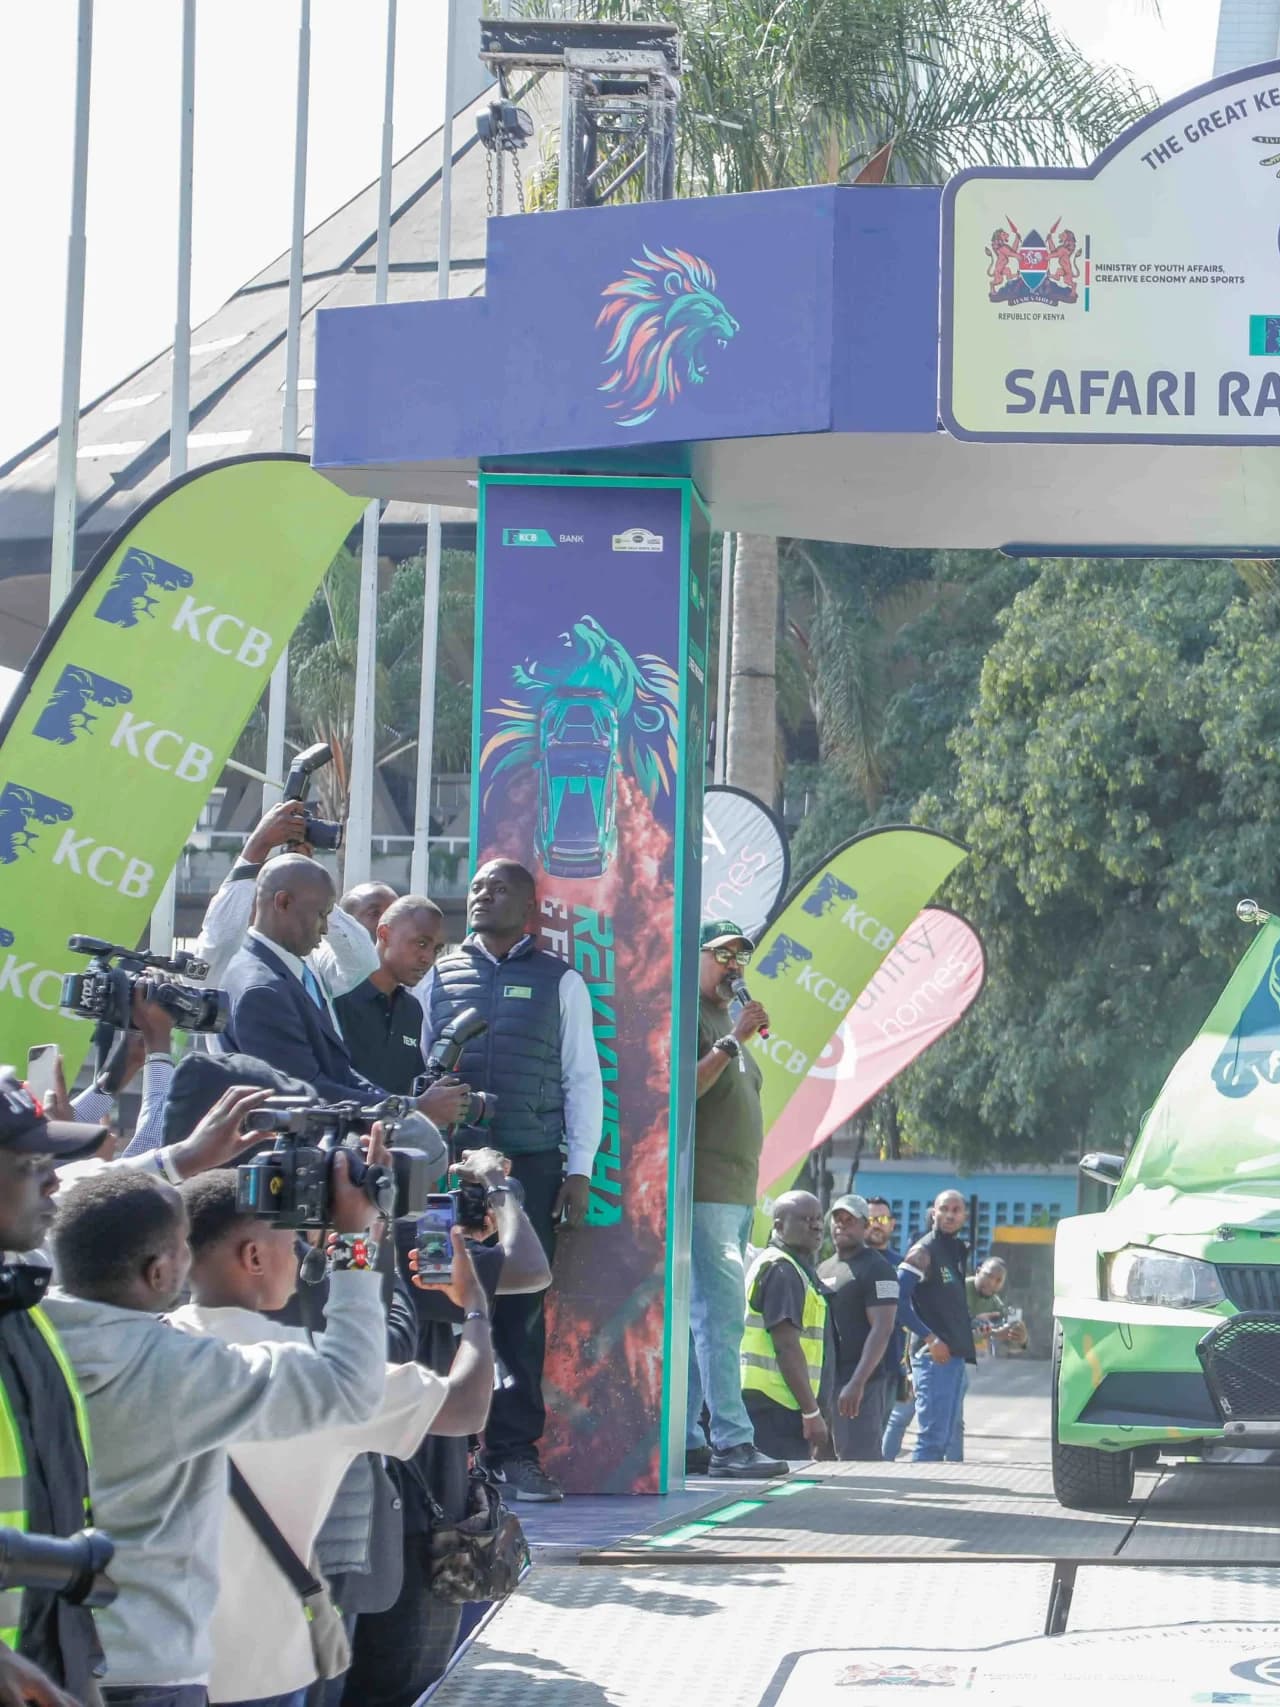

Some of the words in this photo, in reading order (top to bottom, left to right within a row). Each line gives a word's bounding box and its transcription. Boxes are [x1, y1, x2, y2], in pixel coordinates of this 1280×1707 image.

[1140, 136, 1184, 171] THE
[1183, 99, 1249, 143] GREAT
[1095, 263, 1137, 273] MINISTRY
[1139, 263, 1153, 273] OF
[1153, 264, 1185, 273] YOUTH
[1186, 264, 1225, 275] AFFAIRS,
[1095, 274, 1139, 284] CREATIVE
[1140, 274, 1187, 284] ECONOMY
[1188, 275, 1209, 284] AND
[1210, 275, 1246, 285] SPORTS
[998, 312, 1032, 321] REPUBLIC
[1032, 313, 1042, 321] OF
[1042, 313, 1065, 321] KENYA
[1004, 368, 1196, 416] SAFARI
[559, 533, 584, 543] BANK
[170, 596, 274, 669] KCB
[109, 711, 215, 784] KCB
[51, 827, 156, 900] KCB
[840, 904, 896, 952] KCB
[0, 953, 95, 1022] KC
[796, 965, 851, 1013] KCB
[877, 954, 972, 1041] homes
[753, 1030, 809, 1075] KCB
